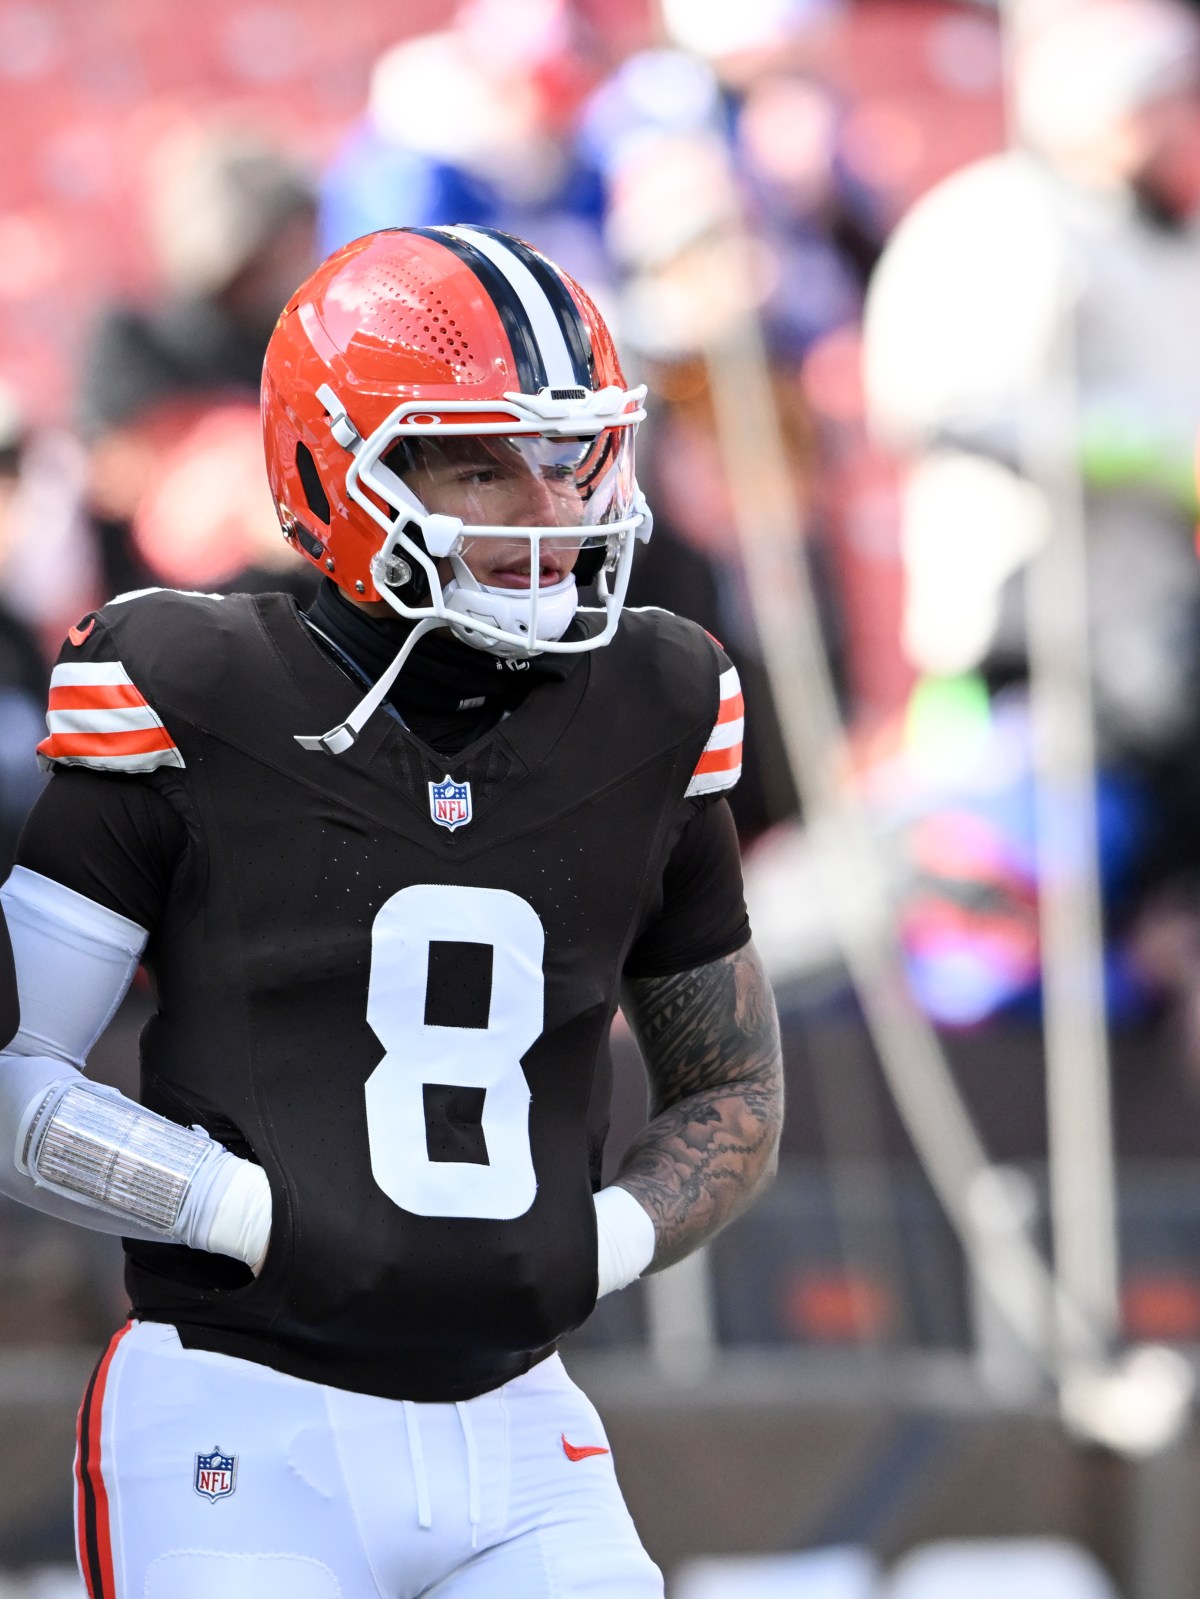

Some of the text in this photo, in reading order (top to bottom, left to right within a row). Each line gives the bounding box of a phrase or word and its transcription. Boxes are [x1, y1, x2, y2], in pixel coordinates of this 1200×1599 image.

[437, 800, 466, 821] NFL
[365, 884, 544, 1220] 8
[199, 1471, 229, 1493] NFL
